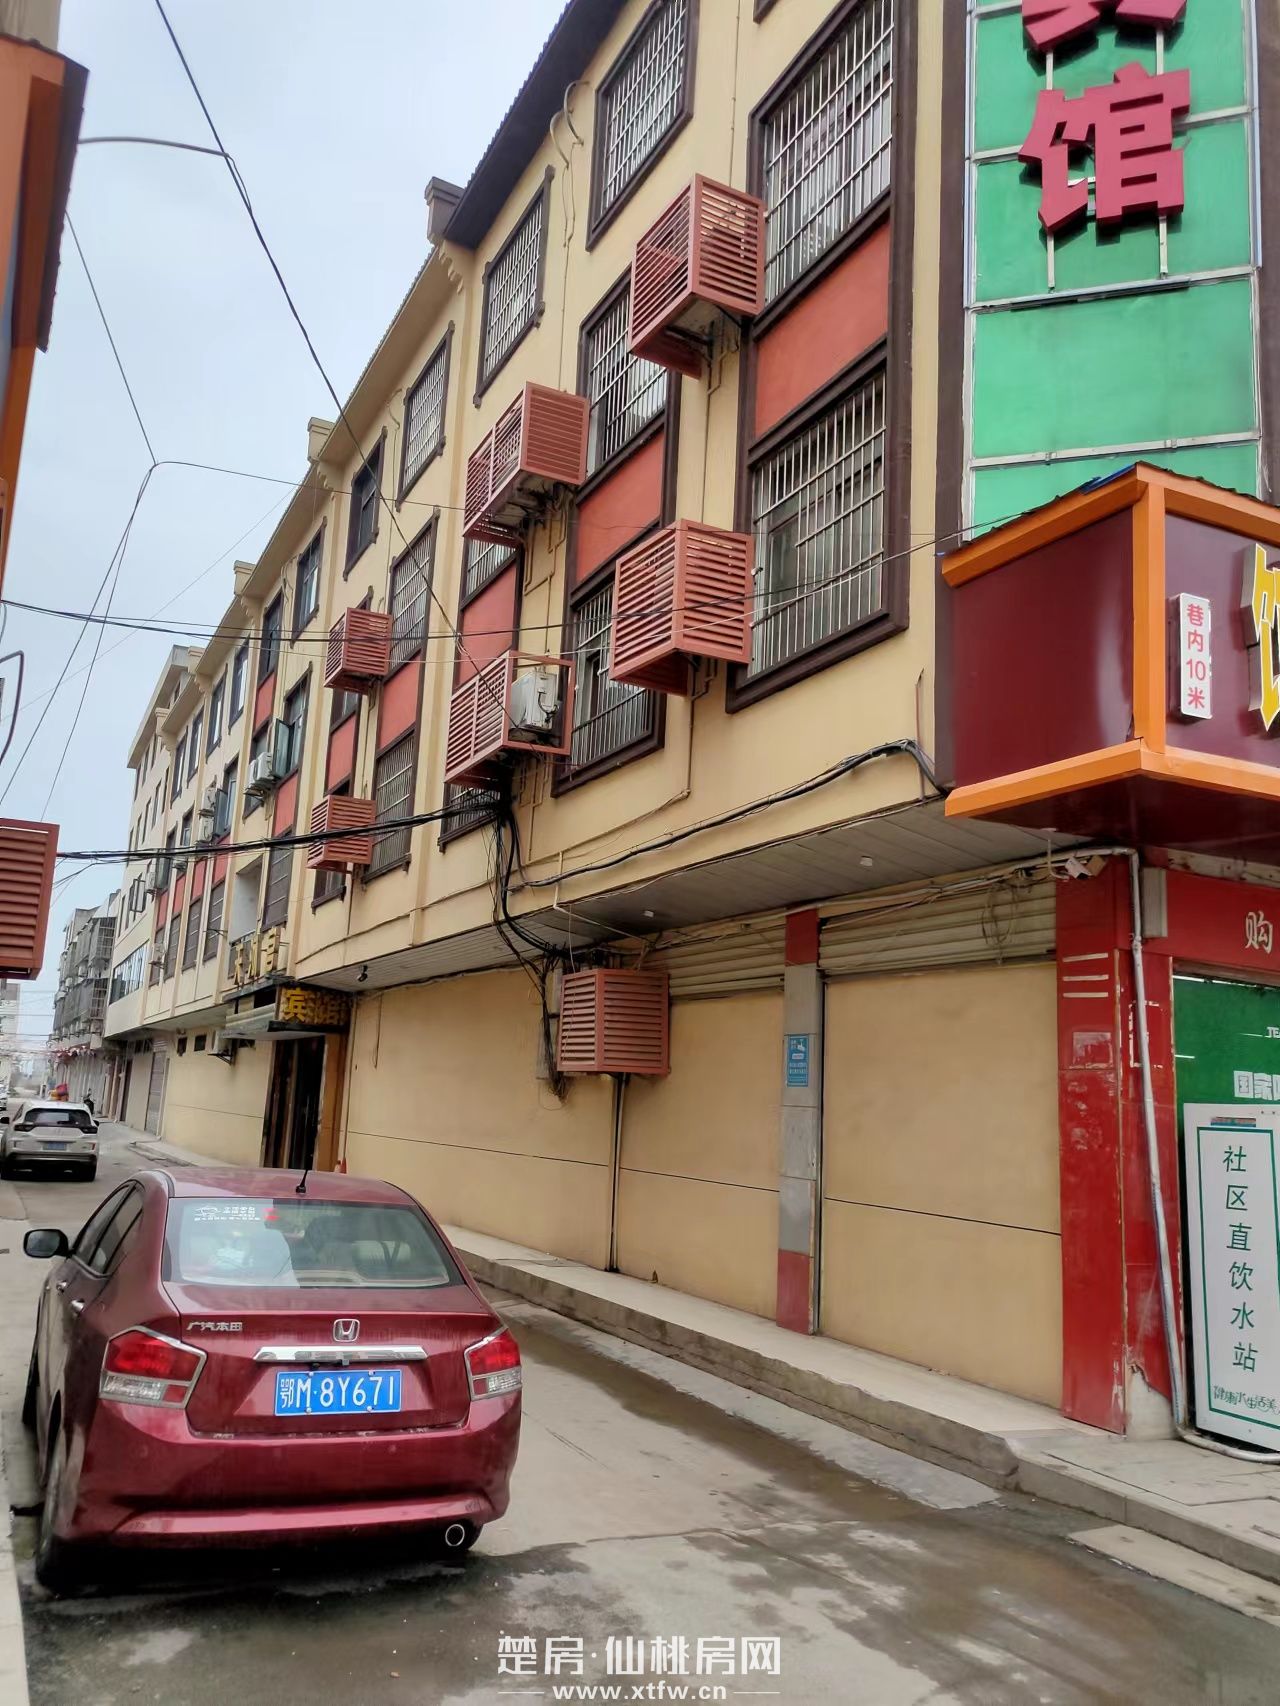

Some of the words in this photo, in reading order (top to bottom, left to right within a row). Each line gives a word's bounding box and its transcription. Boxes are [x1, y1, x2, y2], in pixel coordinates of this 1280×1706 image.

[1186, 603, 1206, 709] 巷内10米
[1245, 911, 1273, 954] 购
[1223, 1145, 1258, 1372] 社区直饮水站
[187, 1321, 243, 1332] 广汽本田
